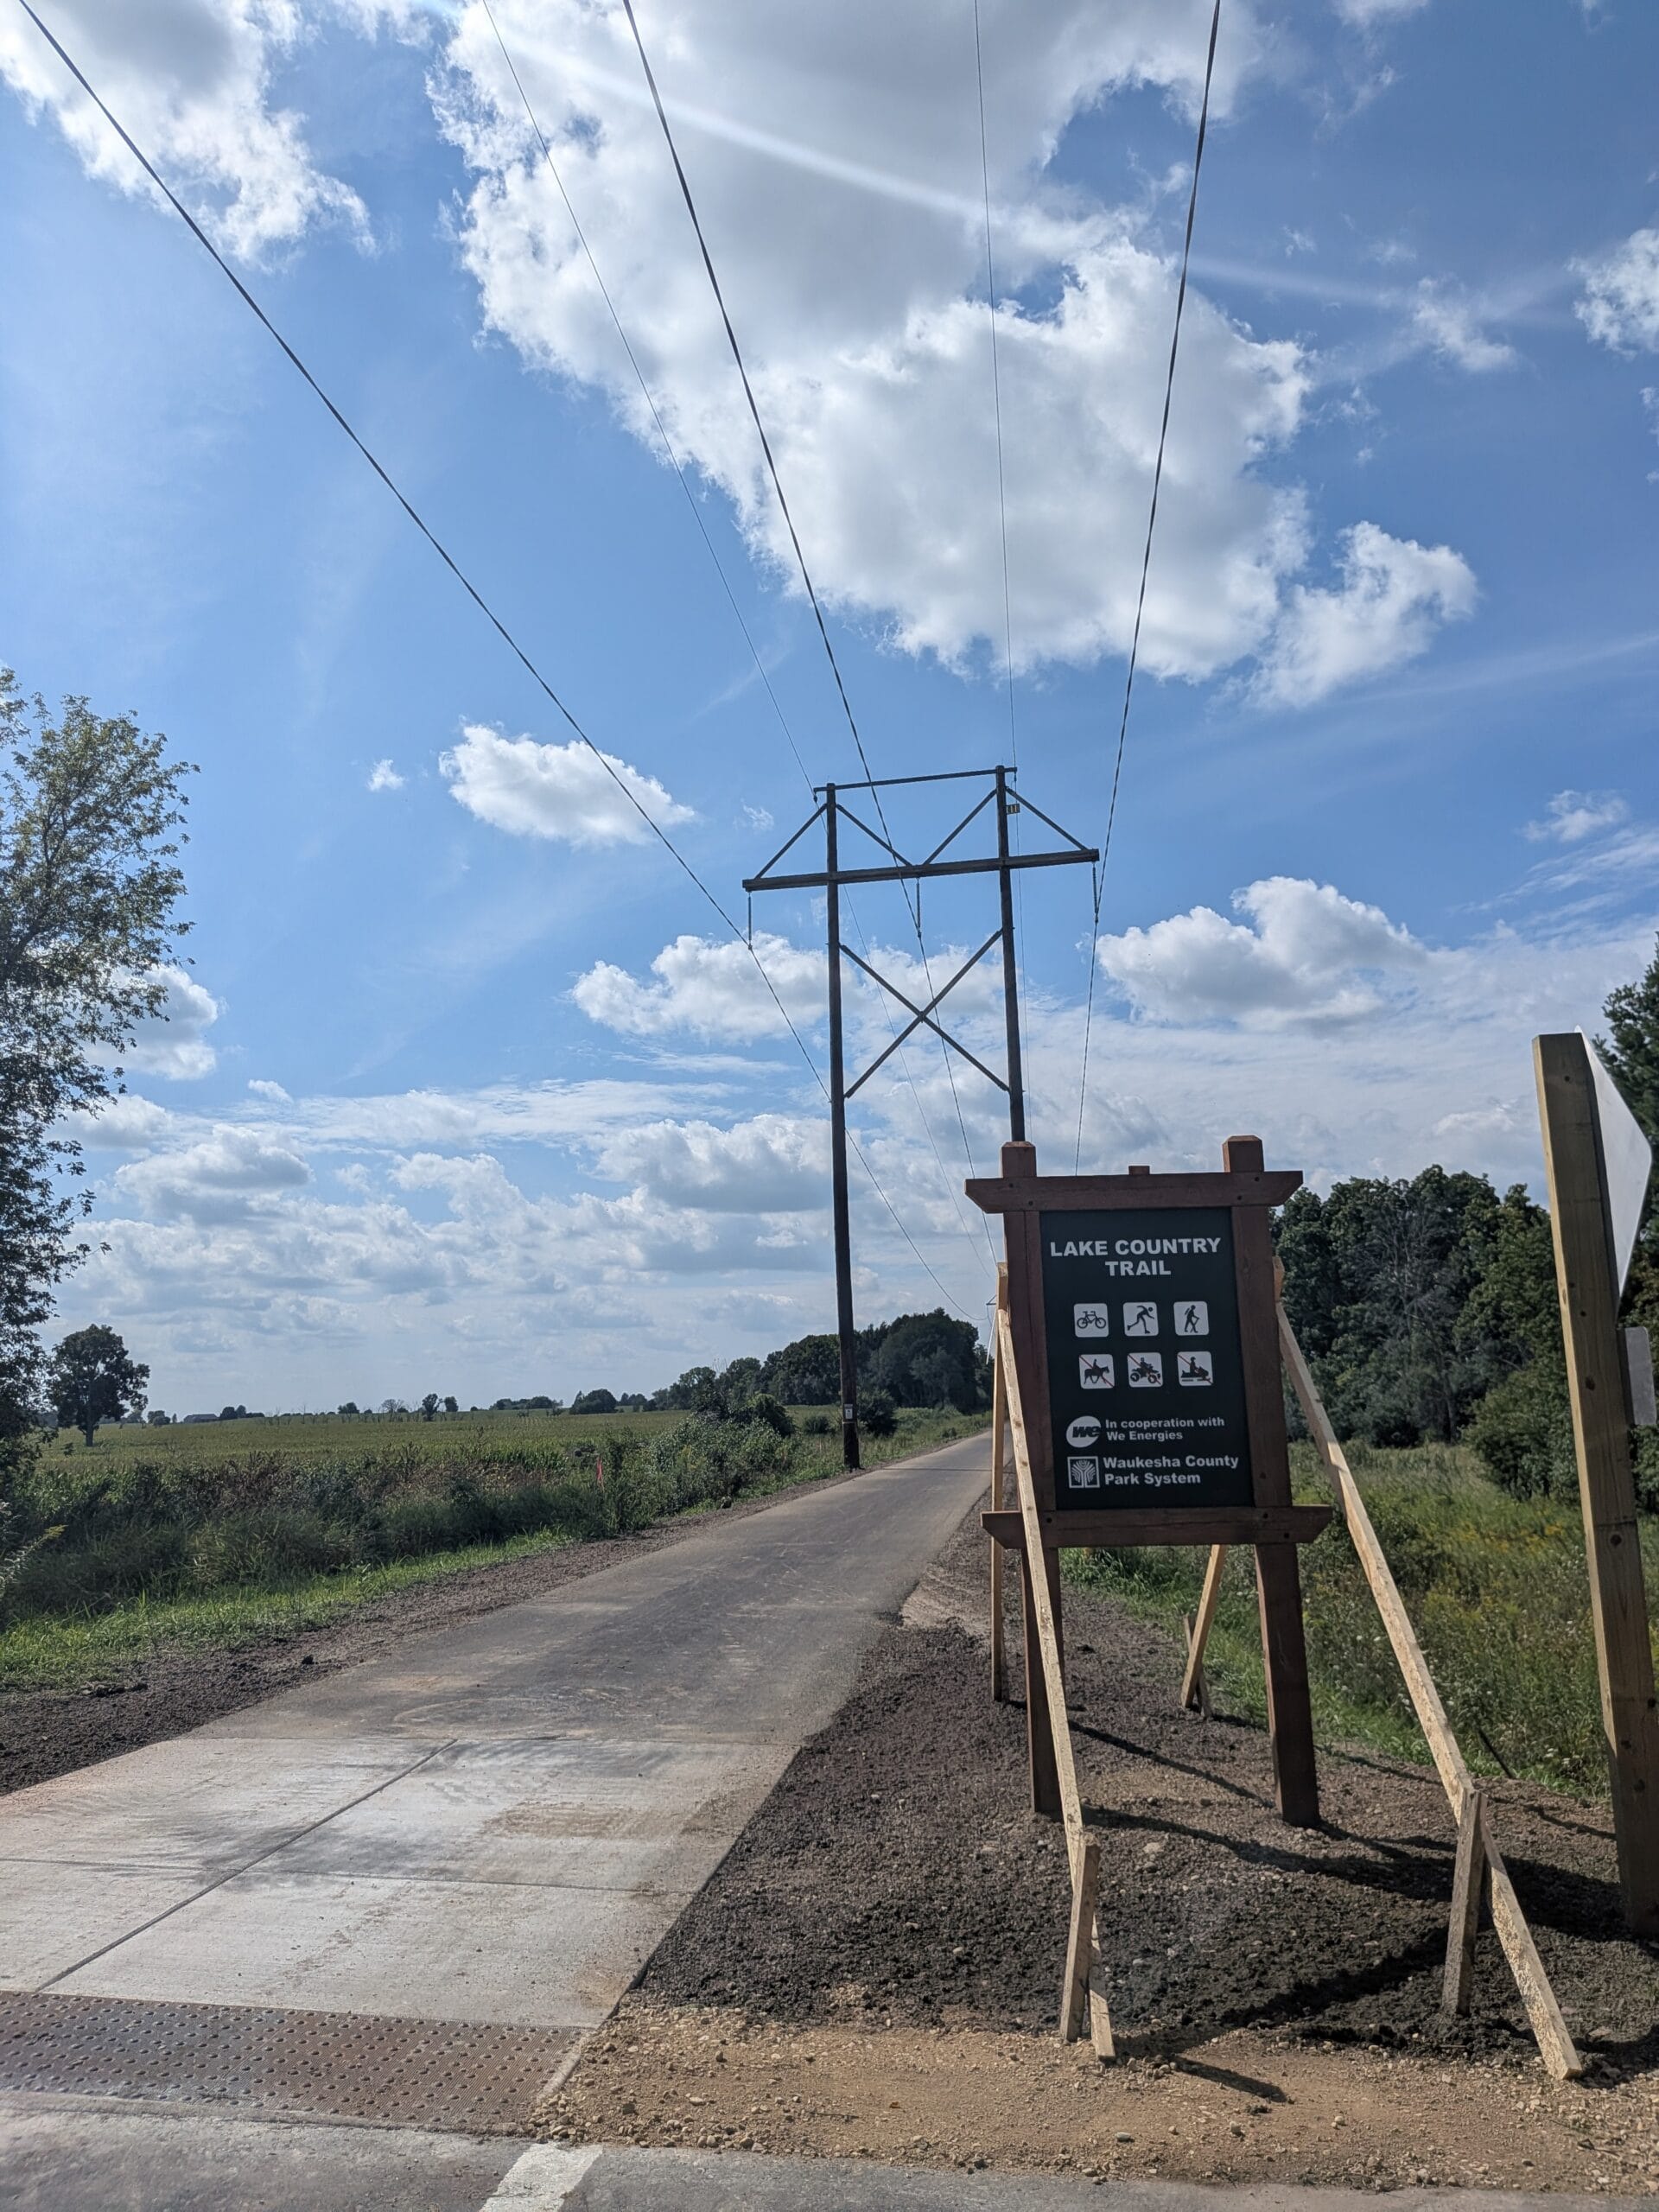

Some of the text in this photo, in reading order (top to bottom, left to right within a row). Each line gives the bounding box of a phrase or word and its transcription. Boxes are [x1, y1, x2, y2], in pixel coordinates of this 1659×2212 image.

[1050, 1237, 1221, 1257] LAKE COUNTRY
[1105, 1260, 1172, 1276] TRAIL
[1105, 1416, 1225, 1431] In cooperation with
[1106, 1429, 1183, 1441] We Energies
[1103, 1454, 1239, 1469] Waukesha County
[1104, 1472, 1201, 1487] Park System
